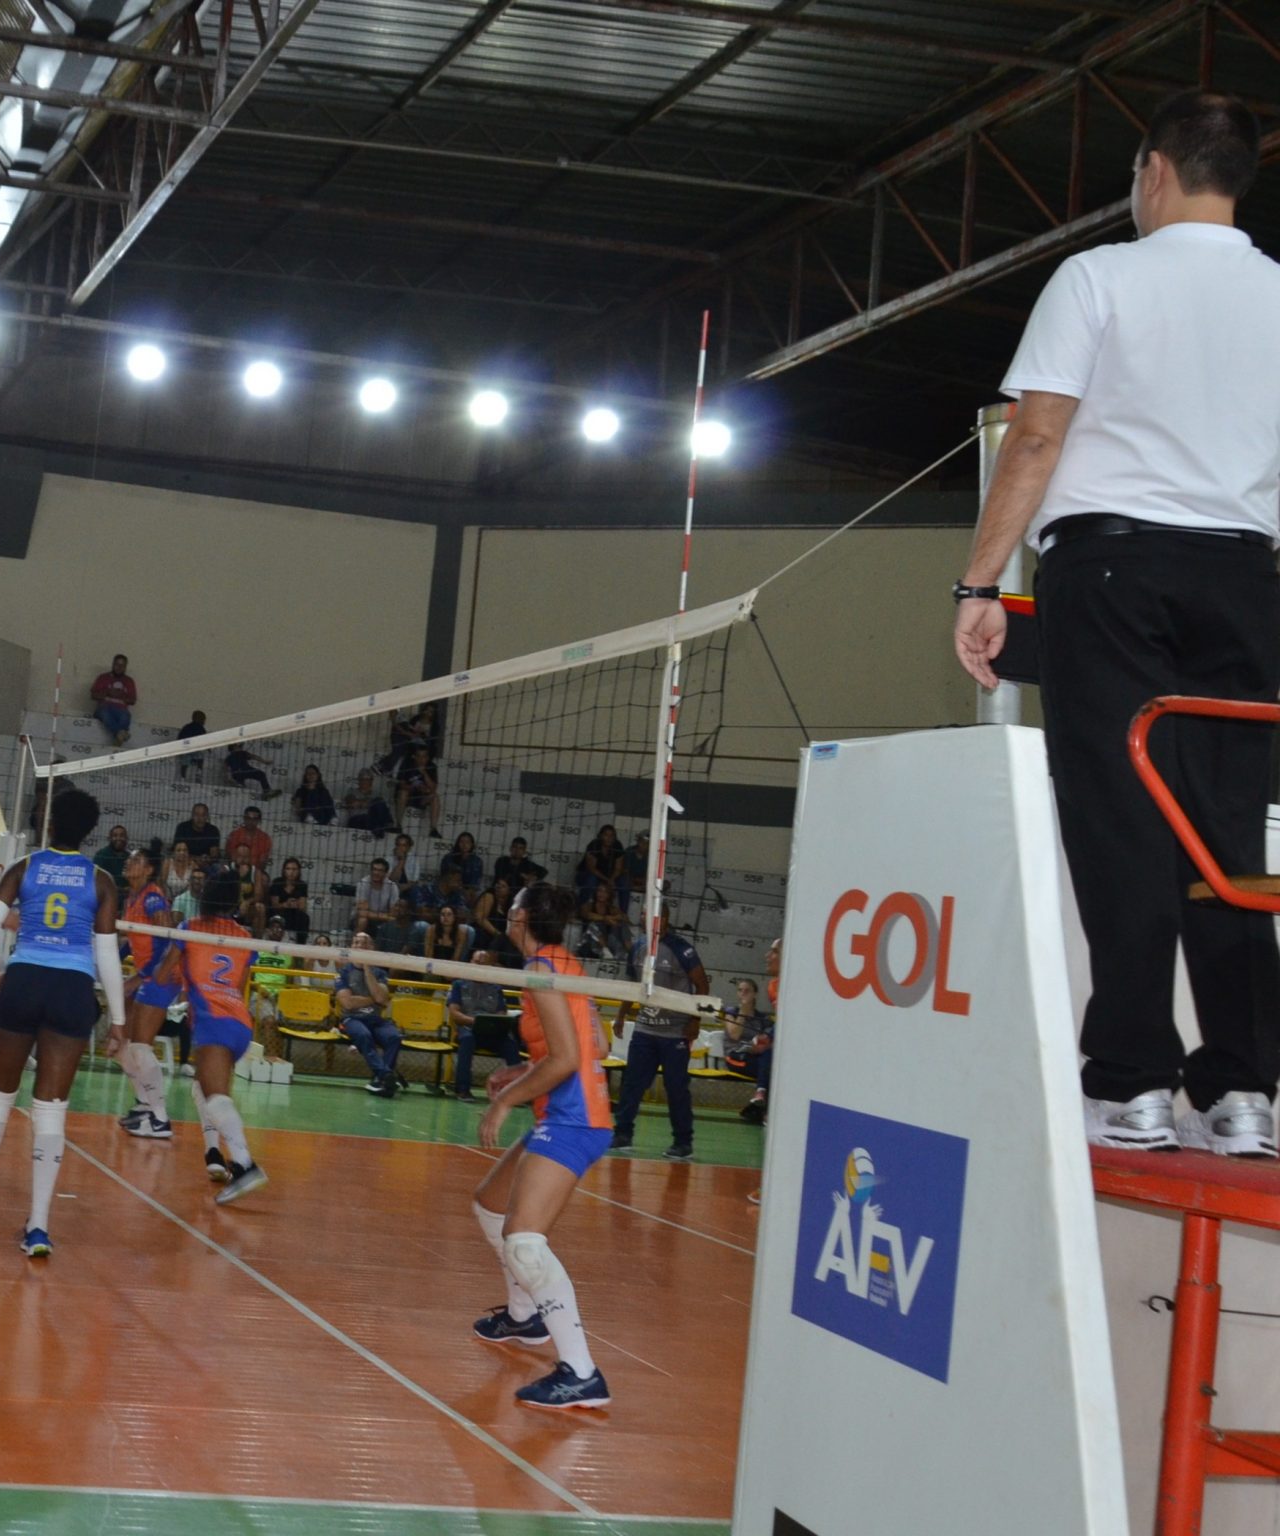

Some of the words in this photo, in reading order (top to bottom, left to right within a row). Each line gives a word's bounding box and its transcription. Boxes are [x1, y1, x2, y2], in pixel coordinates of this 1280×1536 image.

[36, 873, 49, 885] DE
[43, 892, 69, 930] 6
[211, 953, 234, 986] 2
[824, 888, 971, 1016] GOL
[814, 1192, 935, 1317] AFV
